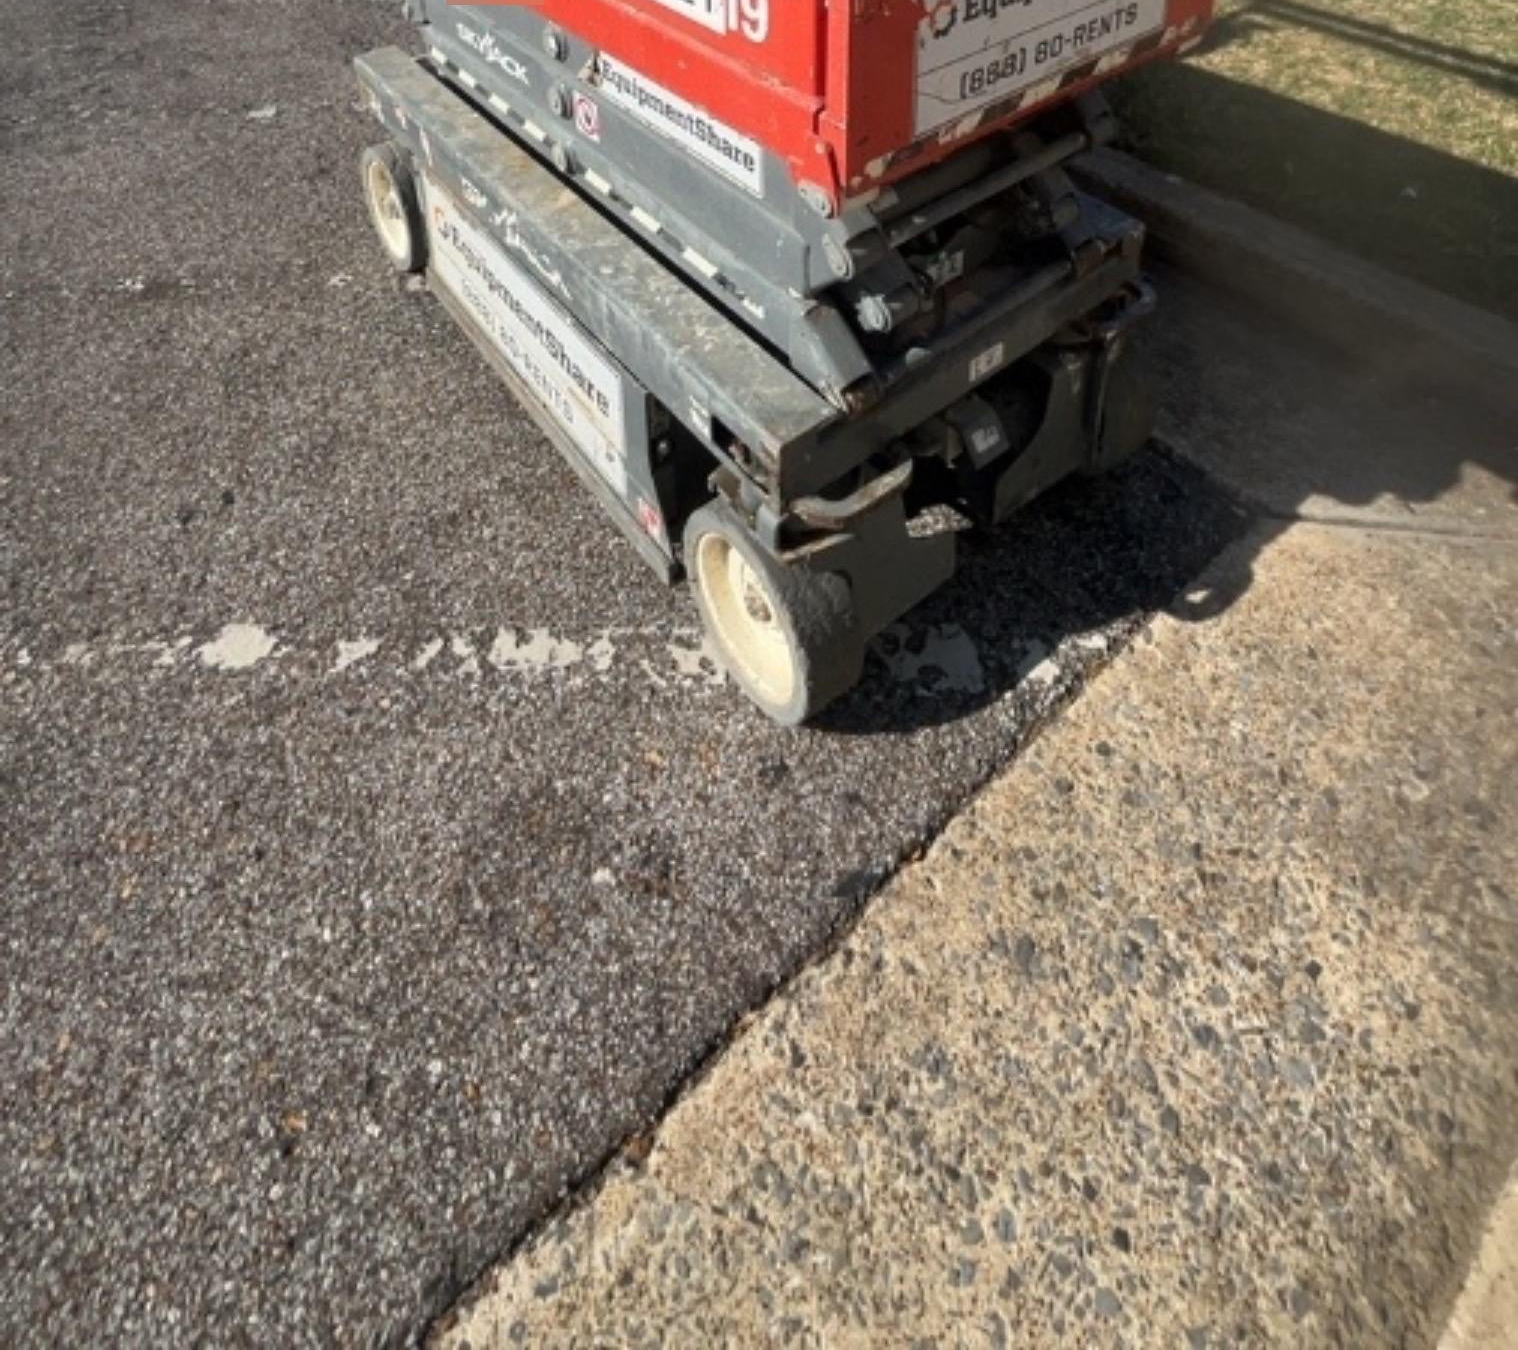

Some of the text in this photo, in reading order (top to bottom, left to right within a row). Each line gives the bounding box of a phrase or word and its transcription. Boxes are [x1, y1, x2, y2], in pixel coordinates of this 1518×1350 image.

[960, 2, 1138, 100] (888) 80-RENTS
[601, 60, 755, 172] EquipmentShare
